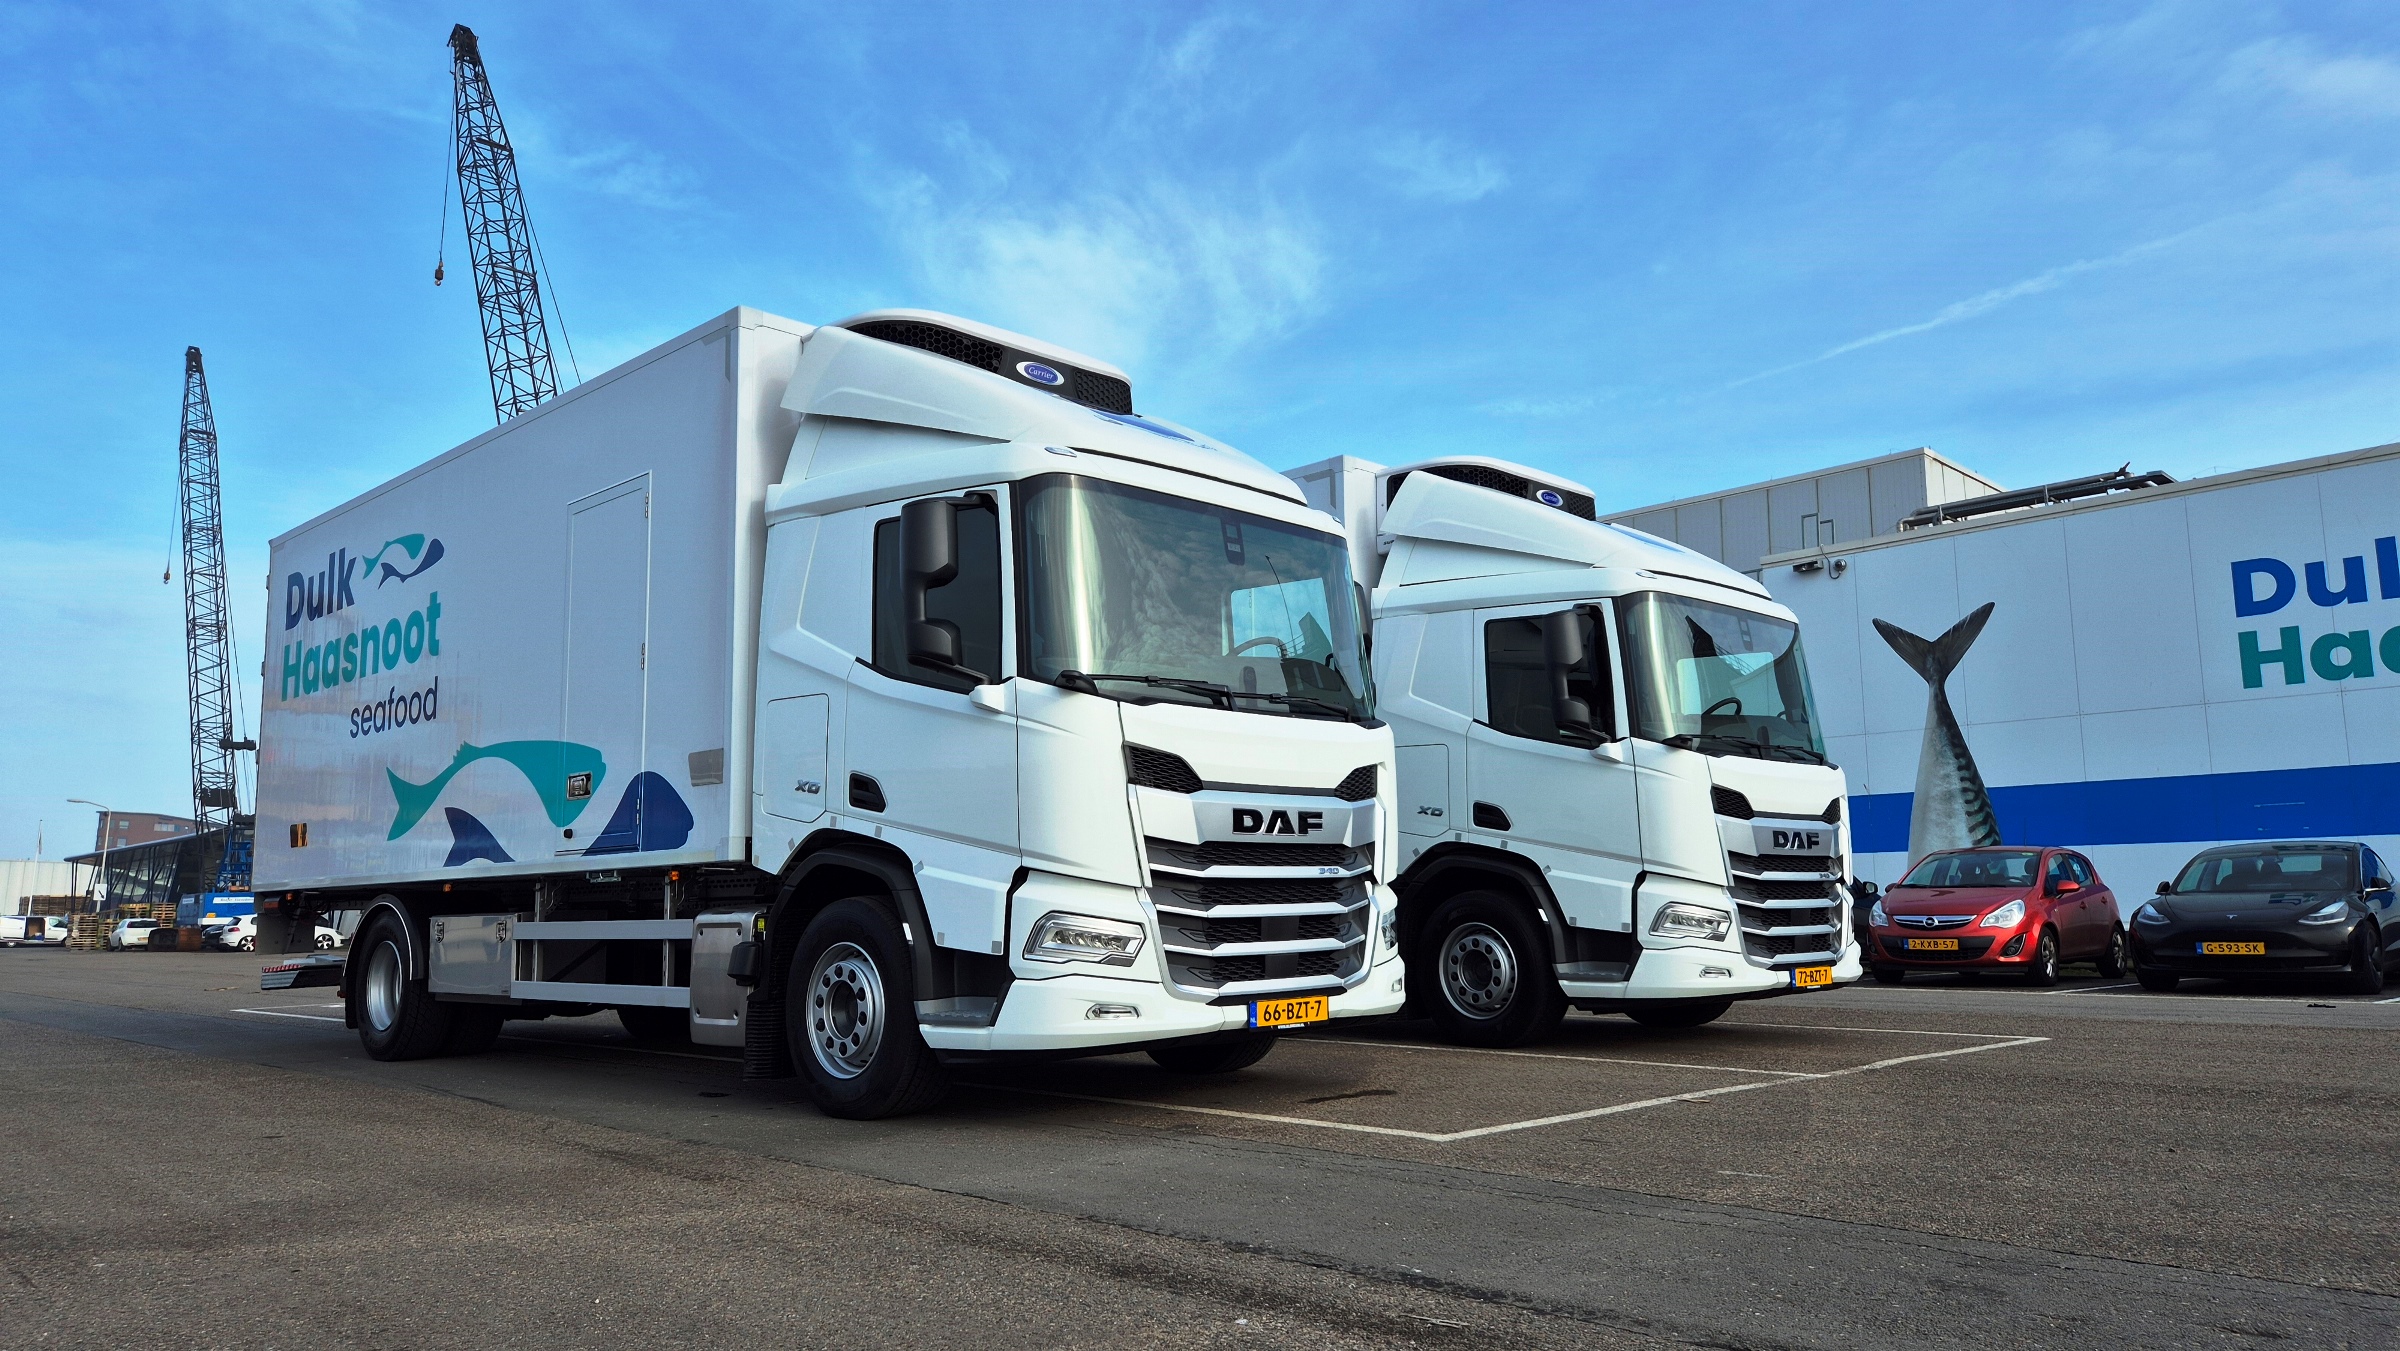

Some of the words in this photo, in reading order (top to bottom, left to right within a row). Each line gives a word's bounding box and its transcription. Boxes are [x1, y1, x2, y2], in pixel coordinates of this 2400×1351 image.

[1028, 366, 1054, 380] Carrier
[285, 547, 357, 631] Dulk
[281, 591, 441, 702] Haasnoot
[350, 675, 438, 739] seafood
[794, 779, 821, 794] XD
[1416, 805, 1444, 817] XD
[1232, 807, 1323, 836] DAF
[1772, 830, 1820, 850] DAF
[1911, 940, 1955, 949] 2-KXB-57
[2206, 943, 2260, 953] G-593-SK
[1798, 969, 1828, 984] 72-BZT-7
[1263, 999, 1322, 1023] 66-BZT-7
